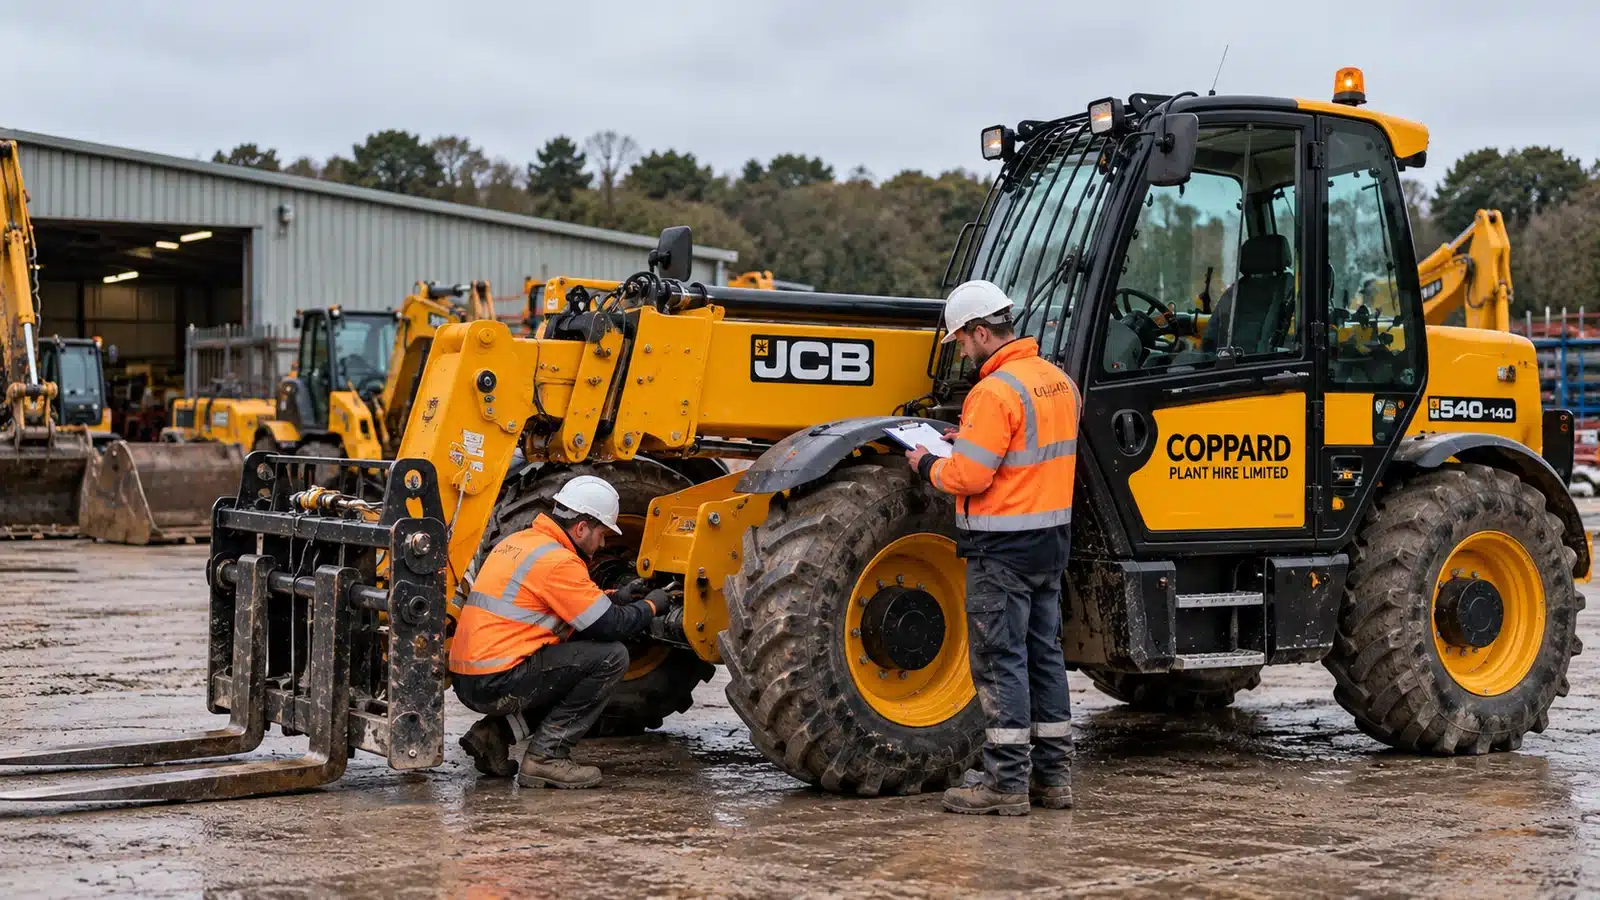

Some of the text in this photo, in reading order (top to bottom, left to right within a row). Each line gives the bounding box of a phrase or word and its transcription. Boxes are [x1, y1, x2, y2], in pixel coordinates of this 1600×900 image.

[754, 340, 871, 382] JCB
[1166, 433, 1291, 462] COPPARD
[1169, 466, 1289, 480] PLANT HIRE LIMITED
